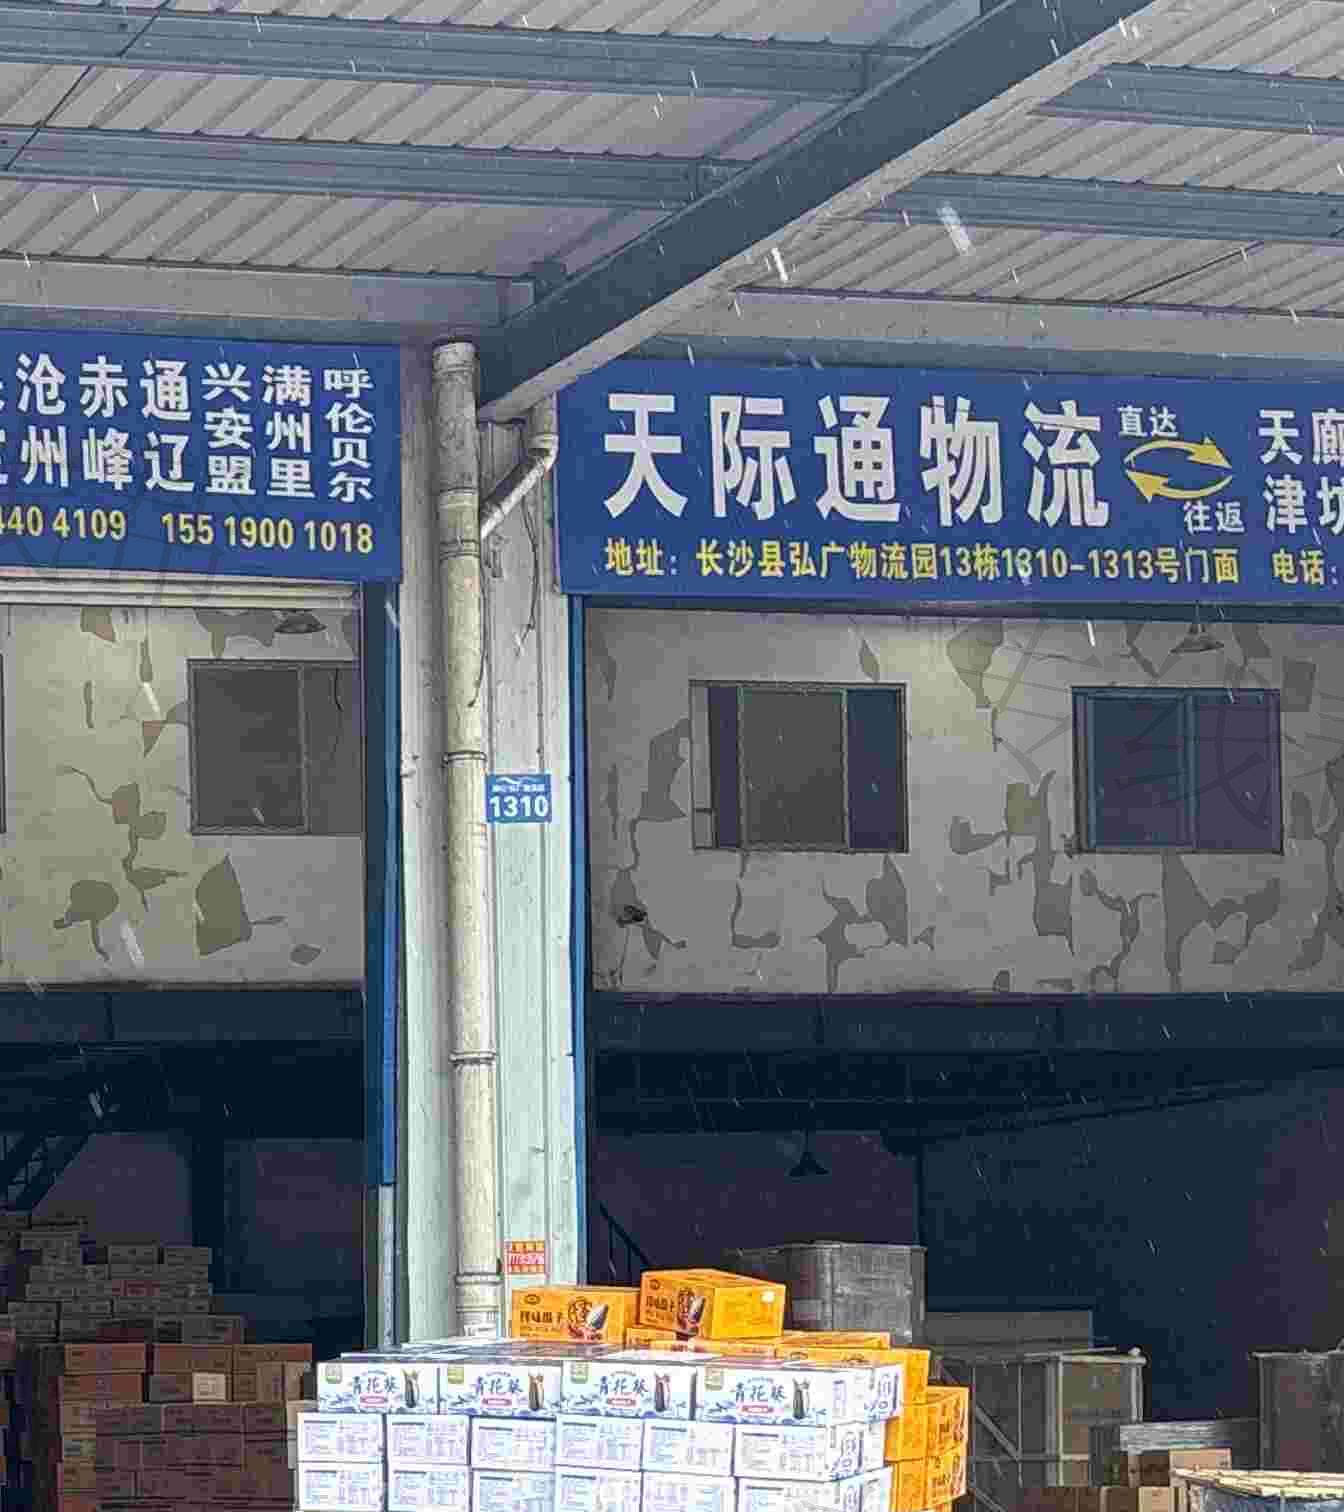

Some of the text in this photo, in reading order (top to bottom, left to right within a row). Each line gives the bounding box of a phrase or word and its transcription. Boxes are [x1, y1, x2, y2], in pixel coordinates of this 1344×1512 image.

[16, 354, 68, 487] 沧州
[80, 356, 132, 490] 赤峰
[140, 360, 194, 491] 通辽
[202, 363, 254, 495] 兴安盟
[262, 365, 314, 497] 满州里
[324, 369, 372, 502] 呼伦贝尔
[604, 394, 1108, 526] 天际通物流
[1118, 405, 1177, 437] 直达
[1259, 410, 1307, 533] 天津
[53, 508, 125, 540] 4109
[162, 513, 213, 544] 155
[225, 517, 293, 549] 1900
[304, 521, 372, 553] 1018
[1184, 501, 1244, 533] 往返
[490, 795, 549, 817] 1310
